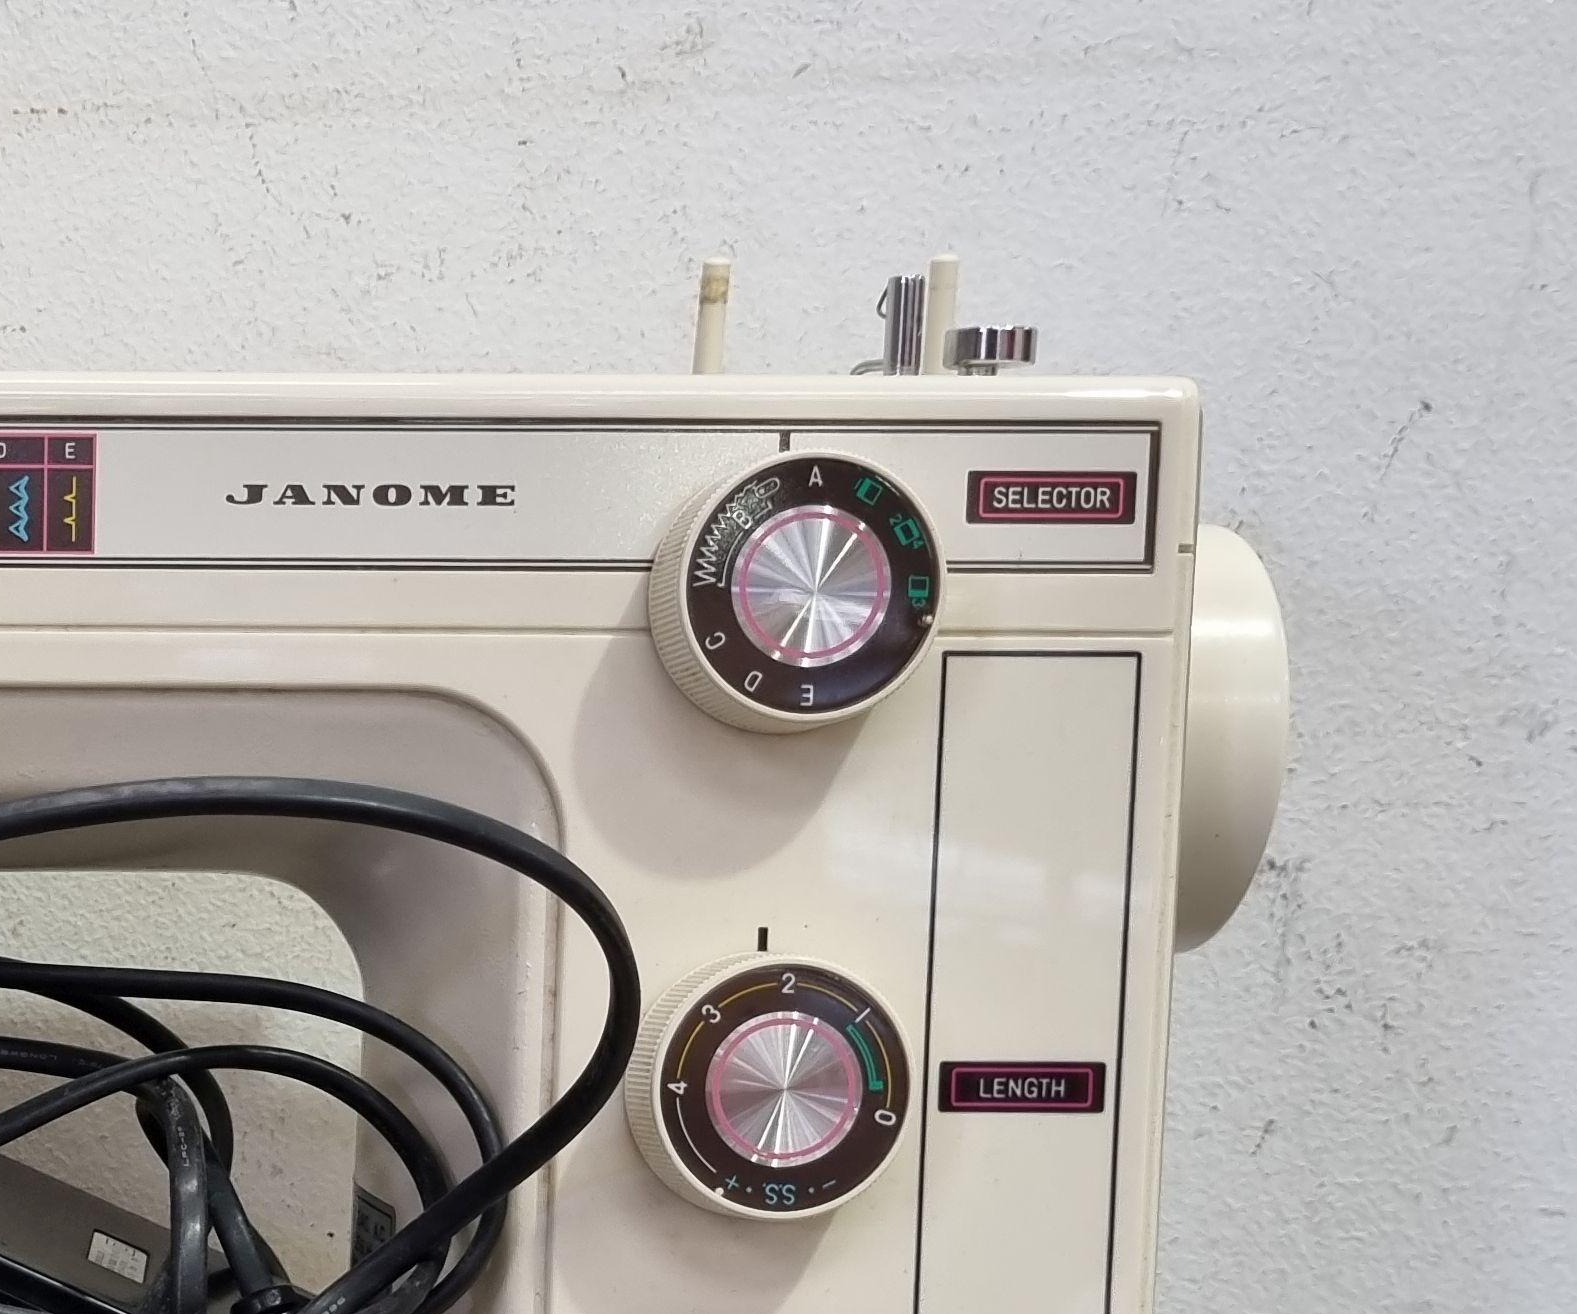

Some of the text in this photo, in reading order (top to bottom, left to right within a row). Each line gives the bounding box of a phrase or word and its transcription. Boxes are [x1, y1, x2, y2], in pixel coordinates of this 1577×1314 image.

[65, 442, 75, 459] E
[808, 464, 823, 487] A
[225, 484, 516, 507] JANOME
[992, 486, 1111, 508] SELECTOR
[732, 510, 753, 530] B
[889, 514, 902, 527] 2
[705, 631, 726, 651] C
[744, 670, 763, 693] D
[800, 684, 814, 706] E
[781, 972, 797, 994] 2
[702, 1004, 722, 1024] 3
[667, 1080, 688, 1096] 4
[978, 1077, 1066, 1099] LENGTH
[874, 1109, 897, 1127] 0
